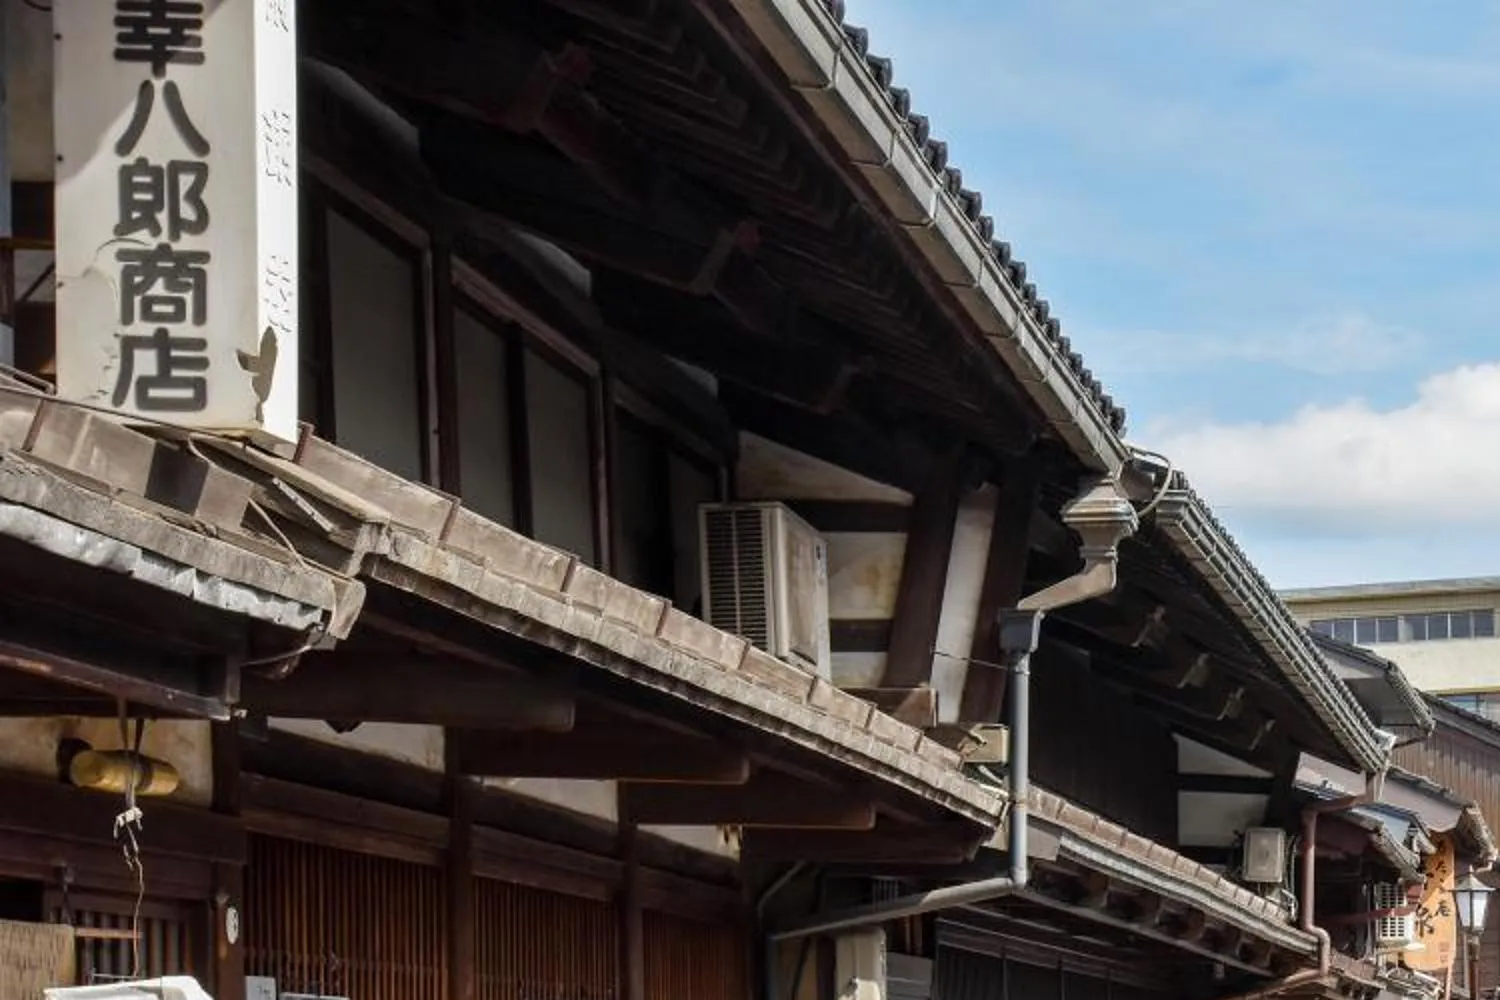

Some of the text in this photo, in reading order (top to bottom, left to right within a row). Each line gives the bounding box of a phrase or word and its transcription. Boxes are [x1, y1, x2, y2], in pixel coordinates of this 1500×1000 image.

[113, 0, 211, 412] 幸八郎商店
